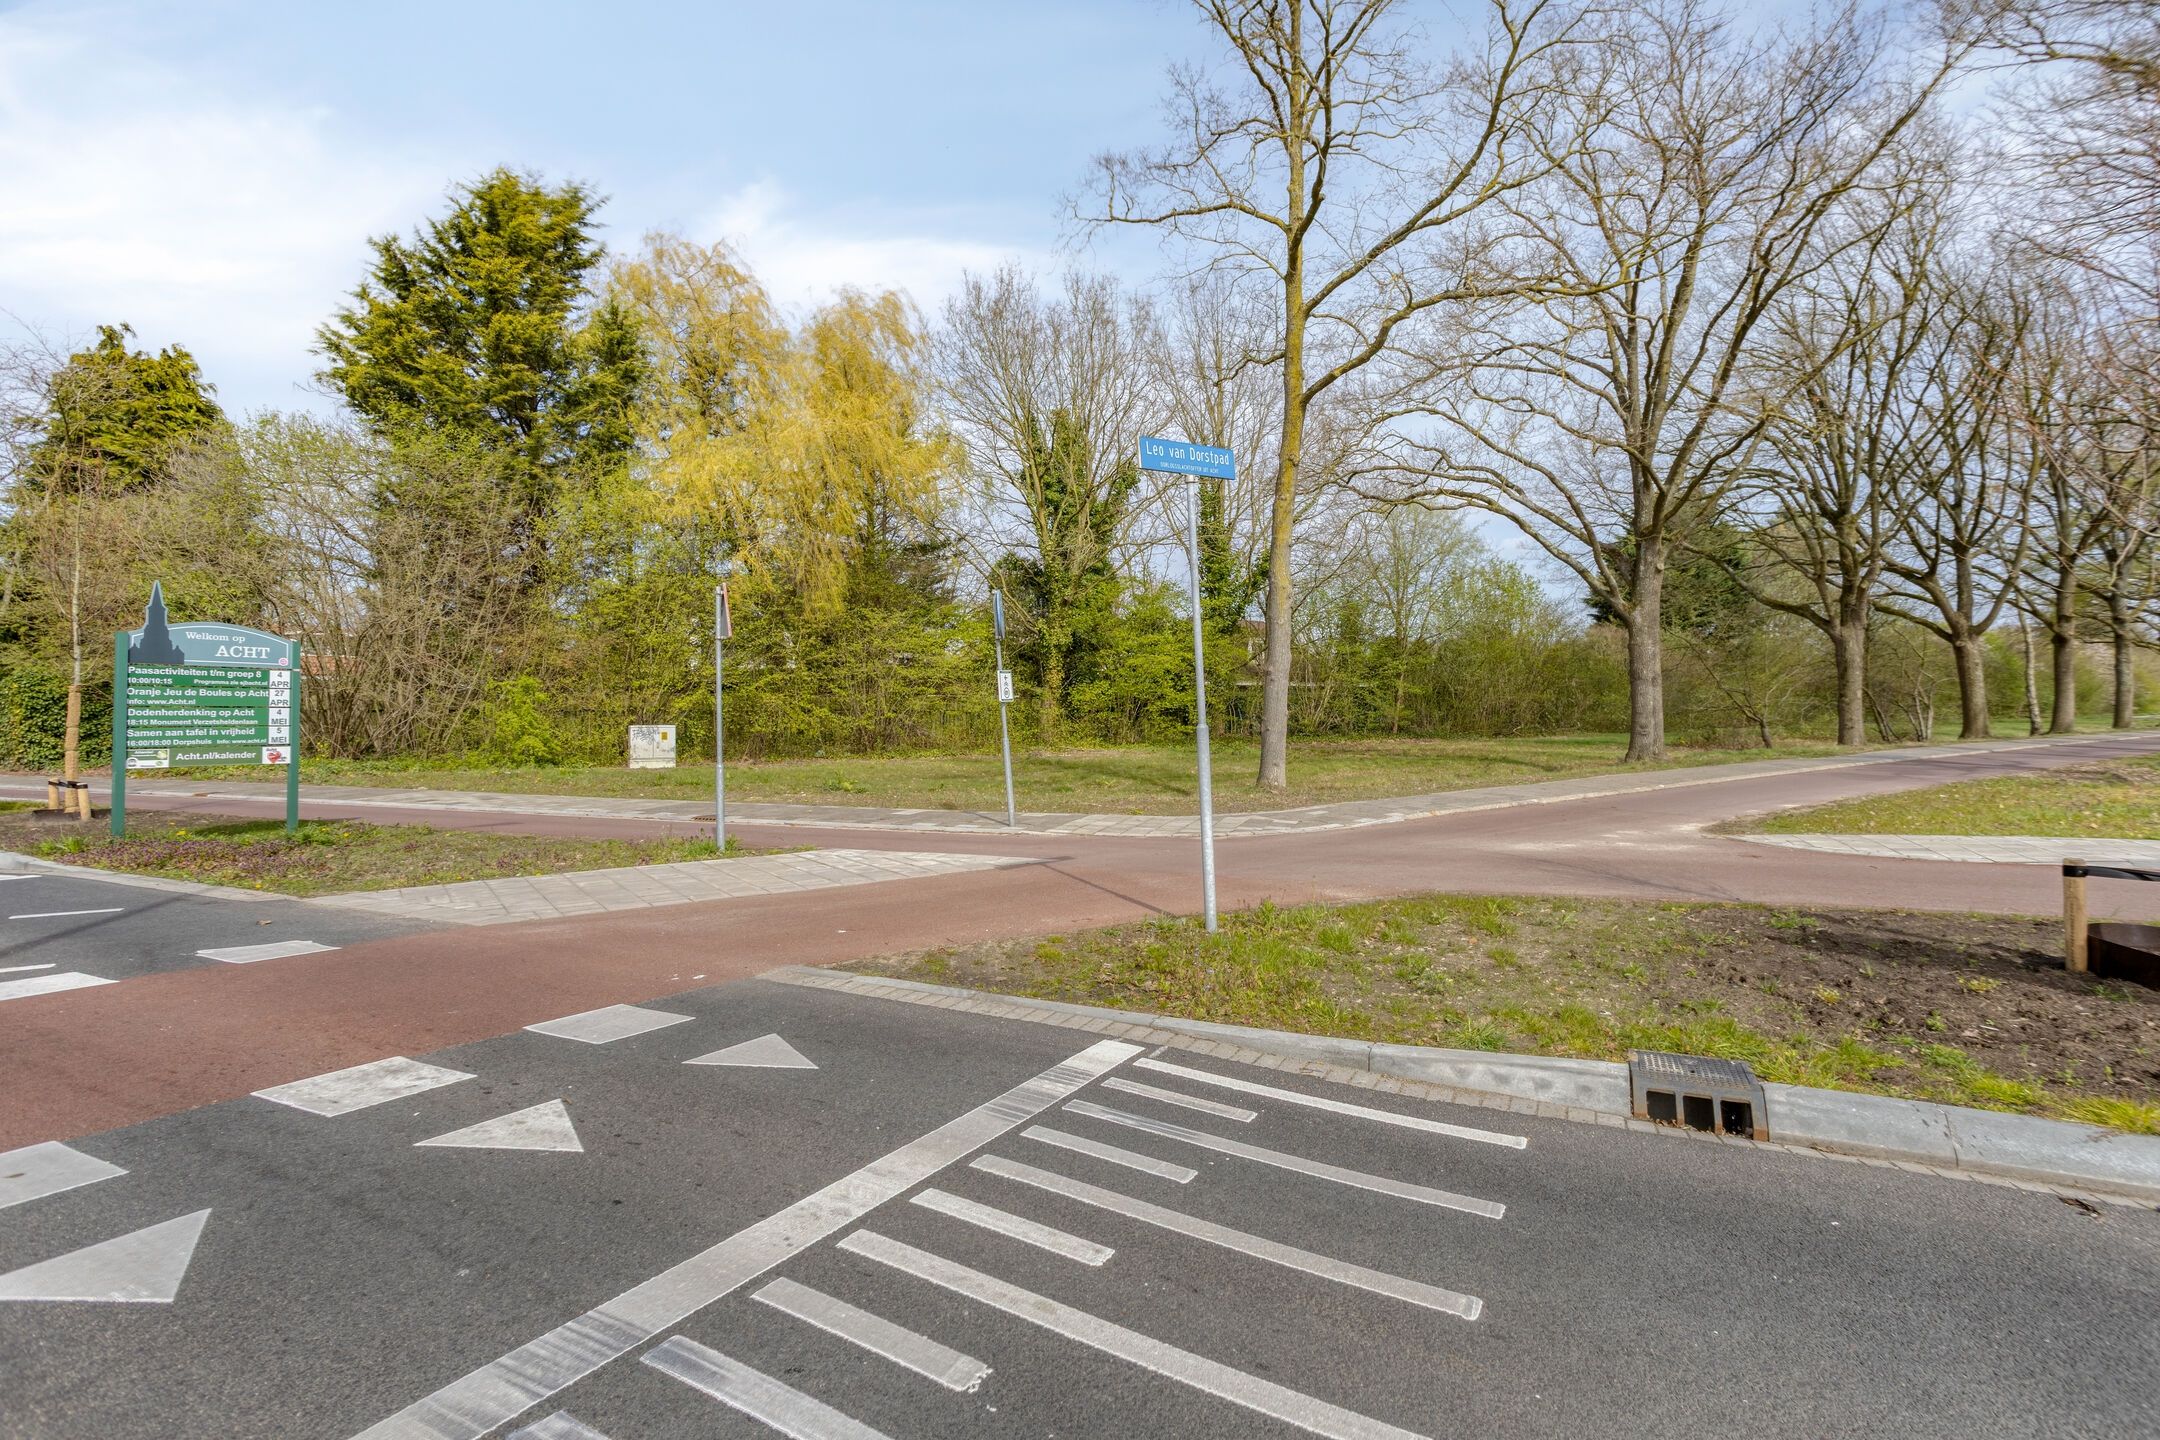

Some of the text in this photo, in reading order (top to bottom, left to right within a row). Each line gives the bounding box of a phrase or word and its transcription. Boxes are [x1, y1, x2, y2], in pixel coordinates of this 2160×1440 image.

[1146, 440, 1229, 466] Leo van Dorstpad
[186, 632, 229, 641] Welkom
[214, 645, 270, 658] ACHT
[128, 666, 208, 676] Paasactiviteiten
[127, 688, 161, 697] Oranje
[128, 708, 216, 717] Dodenherdenking
[220, 728, 255, 736] vrijheid
[176, 752, 256, 760] Acht.nl/kalender
